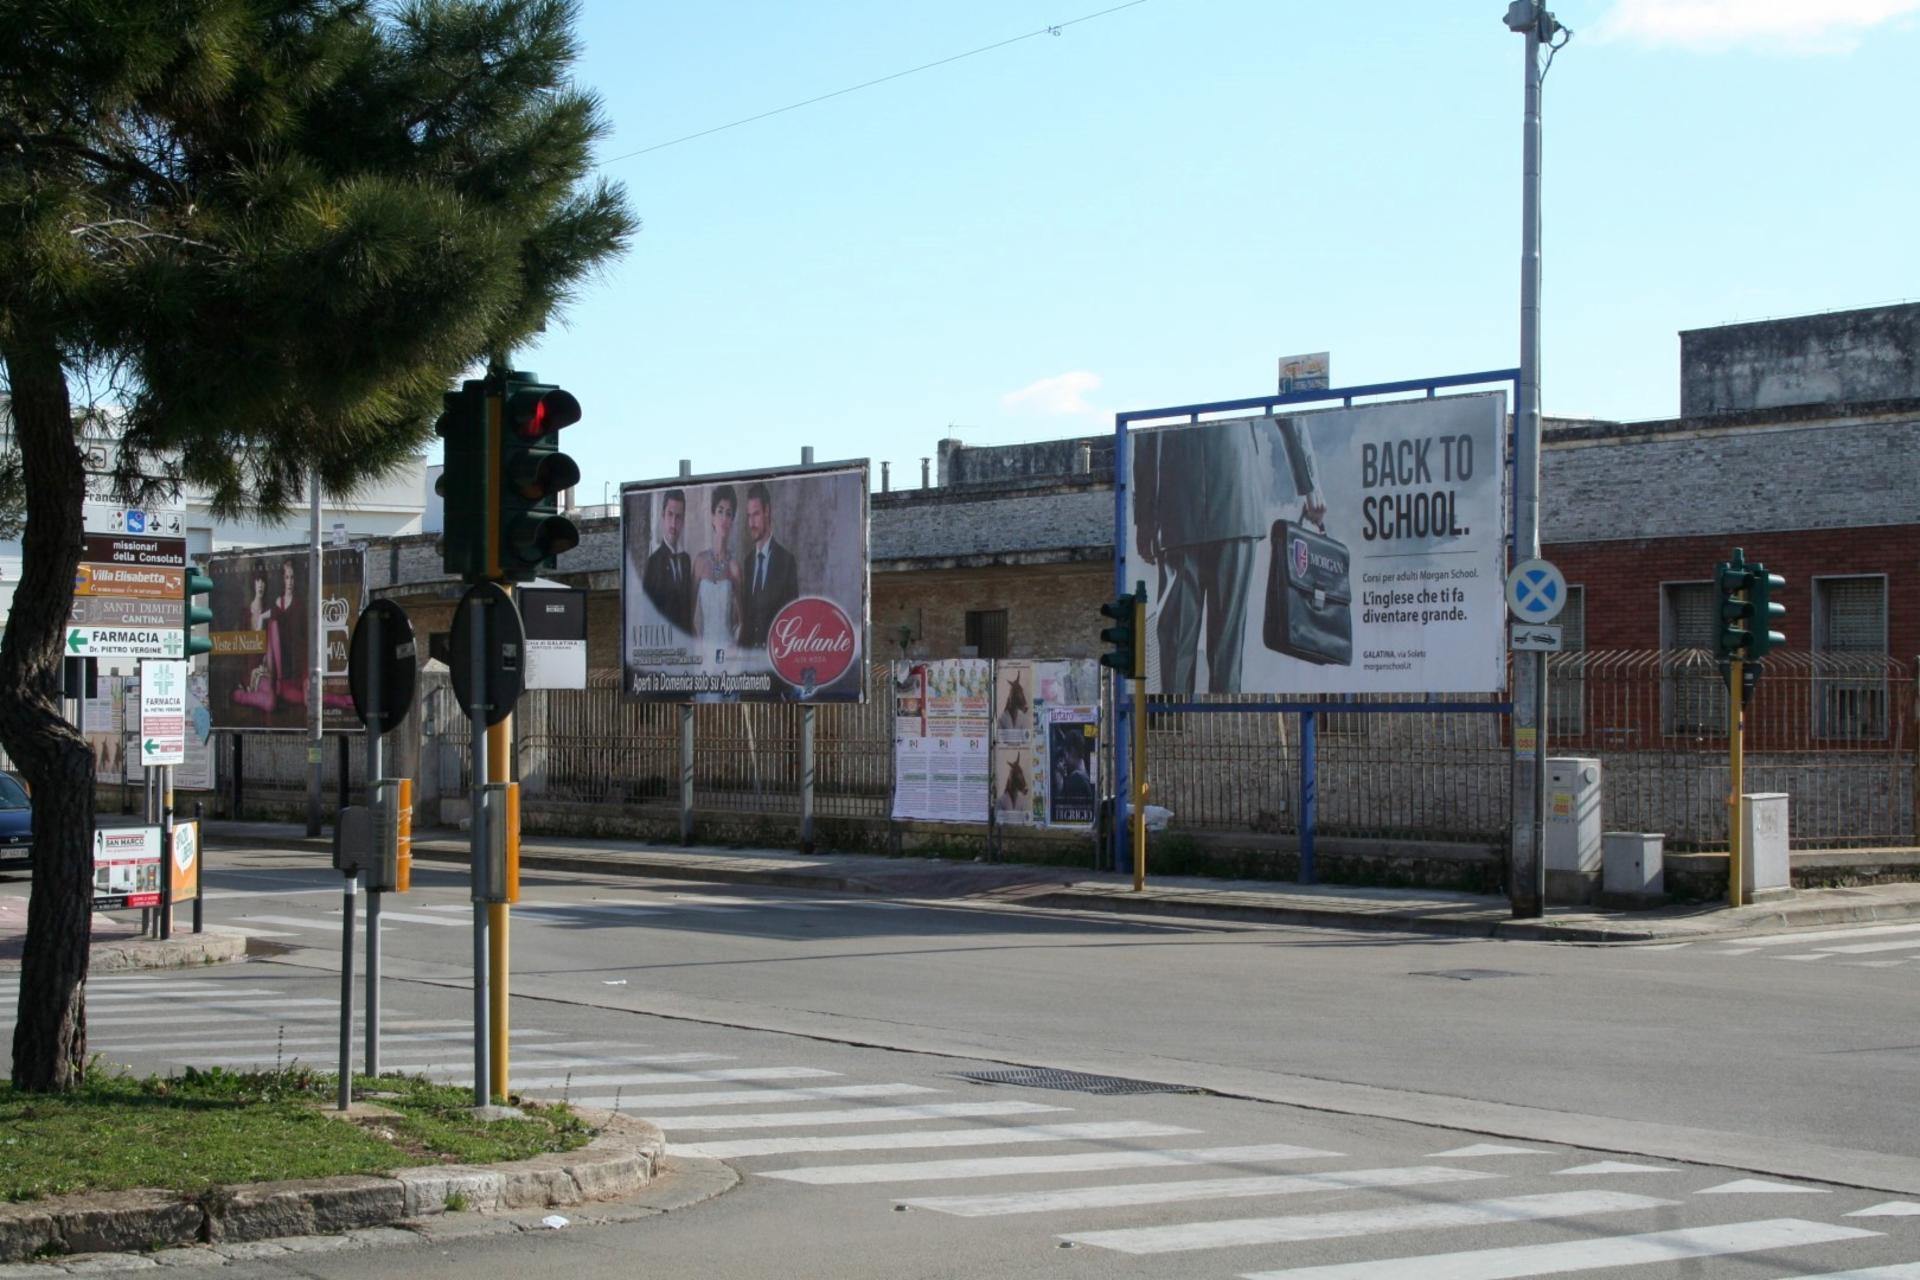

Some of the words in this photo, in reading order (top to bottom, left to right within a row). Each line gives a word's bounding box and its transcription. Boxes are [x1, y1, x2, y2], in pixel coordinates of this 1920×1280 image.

[1362, 437, 1432, 488] BACK
[1440, 433, 1473, 482] TO
[1362, 490, 1470, 541] SCHOOL.
[113, 540, 158, 551] missionari
[113, 552, 136, 562] della
[139, 552, 184, 564] Consolata
[1310, 552, 1344, 574] MORGAN
[92, 569, 114, 581] Villa
[115, 570, 166, 583] Elisabetta
[1363, 573, 1381, 584] Corsi
[1382, 573, 1396, 584] per
[1396, 570, 1419, 582] adulti
[1419, 569, 1449, 582] Morgan
[1450, 568, 1479, 580] School.
[1416, 587, 1438, 604] che
[1440, 587, 1450, 603] ti
[1452, 586, 1465, 603] fa
[103, 602, 136, 613] SANTI
[140, 602, 183, 614] DIMITRI
[1362, 608, 1419, 624] diventare
[1421, 606, 1468, 625] grande.
[121, 614, 165, 624] CANTINA
[92, 631, 159, 643] FARMACIA
[212, 636, 232, 651] Veste
[239, 634, 264, 650] Natale
[774, 615, 851, 659] Galante
[130, 646, 162, 654] VERGINE
[660, 673, 694, 691] Domenica
[695, 672, 709, 690] solo
[710, 676, 720, 691] su
[720, 670, 771, 695] Appuntamento
[145, 697, 181, 705] FARMACIA
[106, 839, 120, 847] SAN
[120, 838, 144, 847] MARCO
